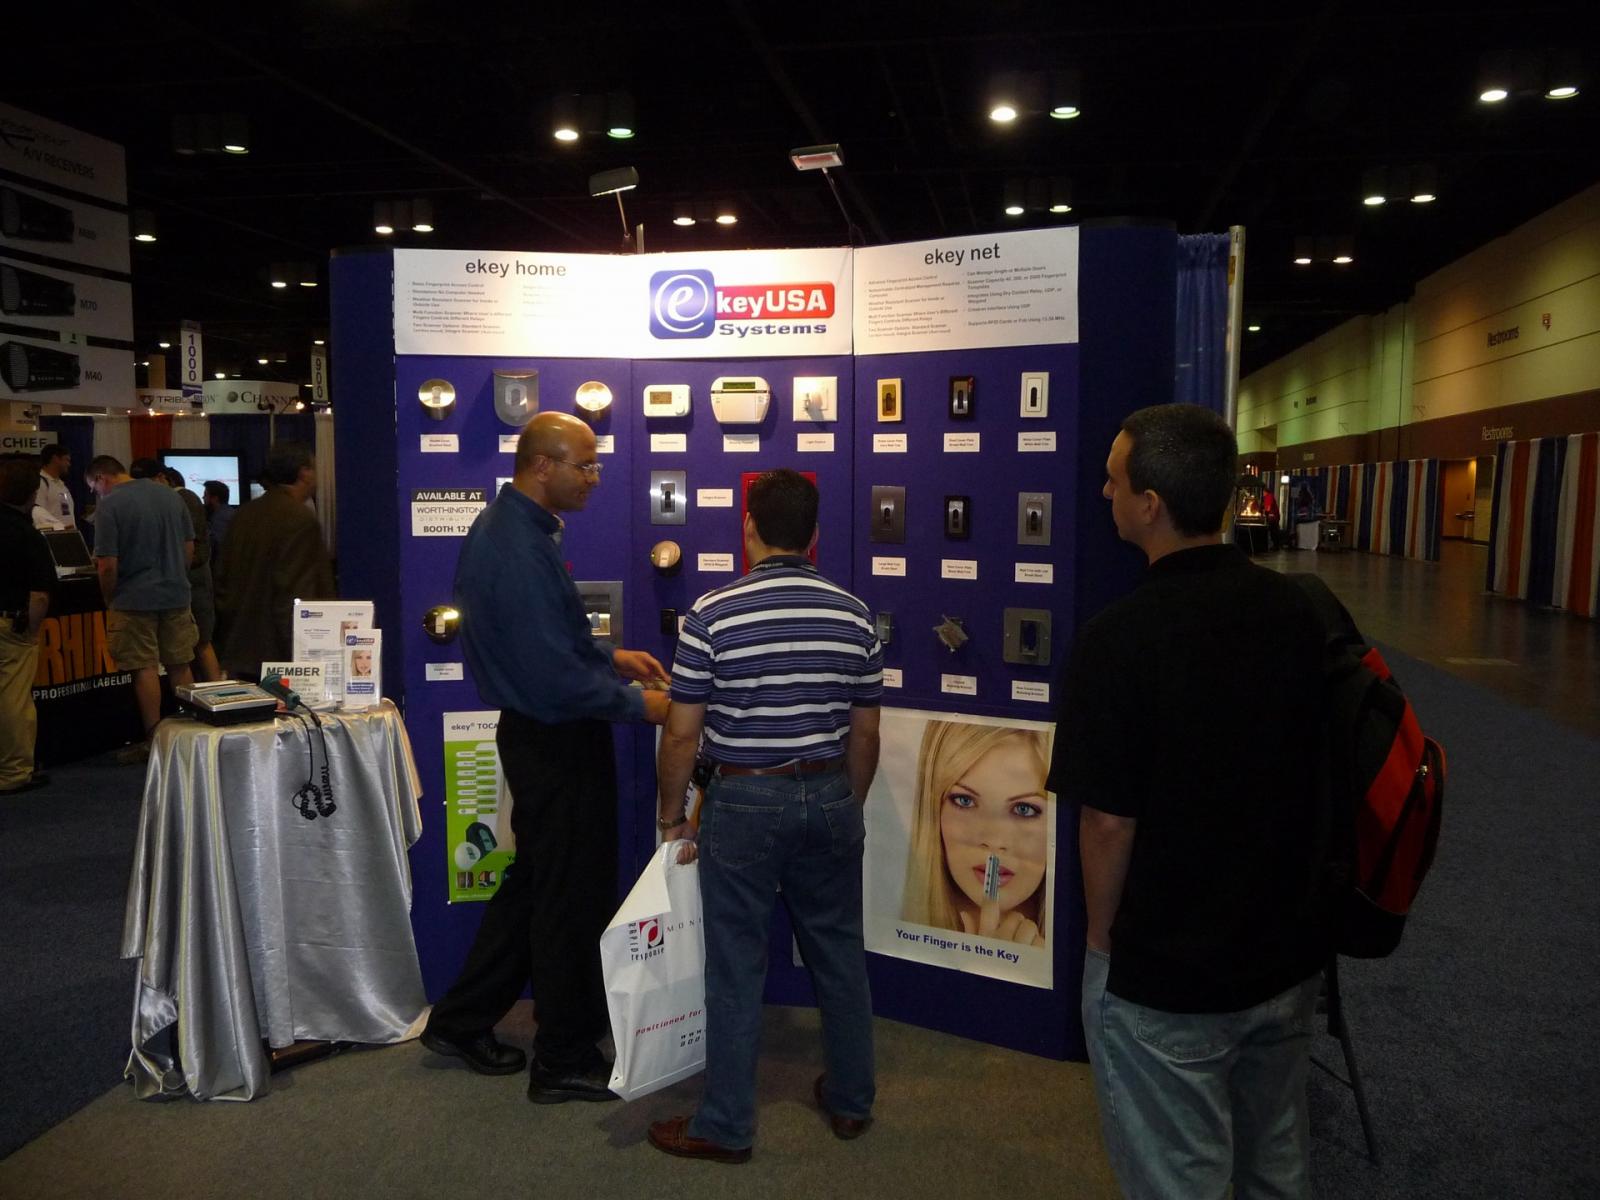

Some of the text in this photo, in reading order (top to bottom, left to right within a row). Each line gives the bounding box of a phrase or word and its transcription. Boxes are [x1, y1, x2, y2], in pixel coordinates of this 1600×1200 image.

[924, 243, 1000, 266] ekey net
[465, 259, 567, 278] ekey home
[80, 299, 97, 311] M70
[719, 323, 827, 338] Systems
[1487, 326, 1520, 348] Restrooms
[187, 334, 197, 382] 1000
[85, 370, 102, 381] M40
[315, 357, 325, 399] 900
[1481, 424, 1514, 441] Restrooms
[2, 437, 48, 449] CHIEF
[416, 492, 482, 501] AVAILABLE AT
[423, 525, 454, 533] BOOTH
[266, 667, 320, 677] MEMBER
[896, 928, 1020, 964] Your Finger is the Key
[631, 947, 664, 961] response
[689, 1009, 702, 1018] for
